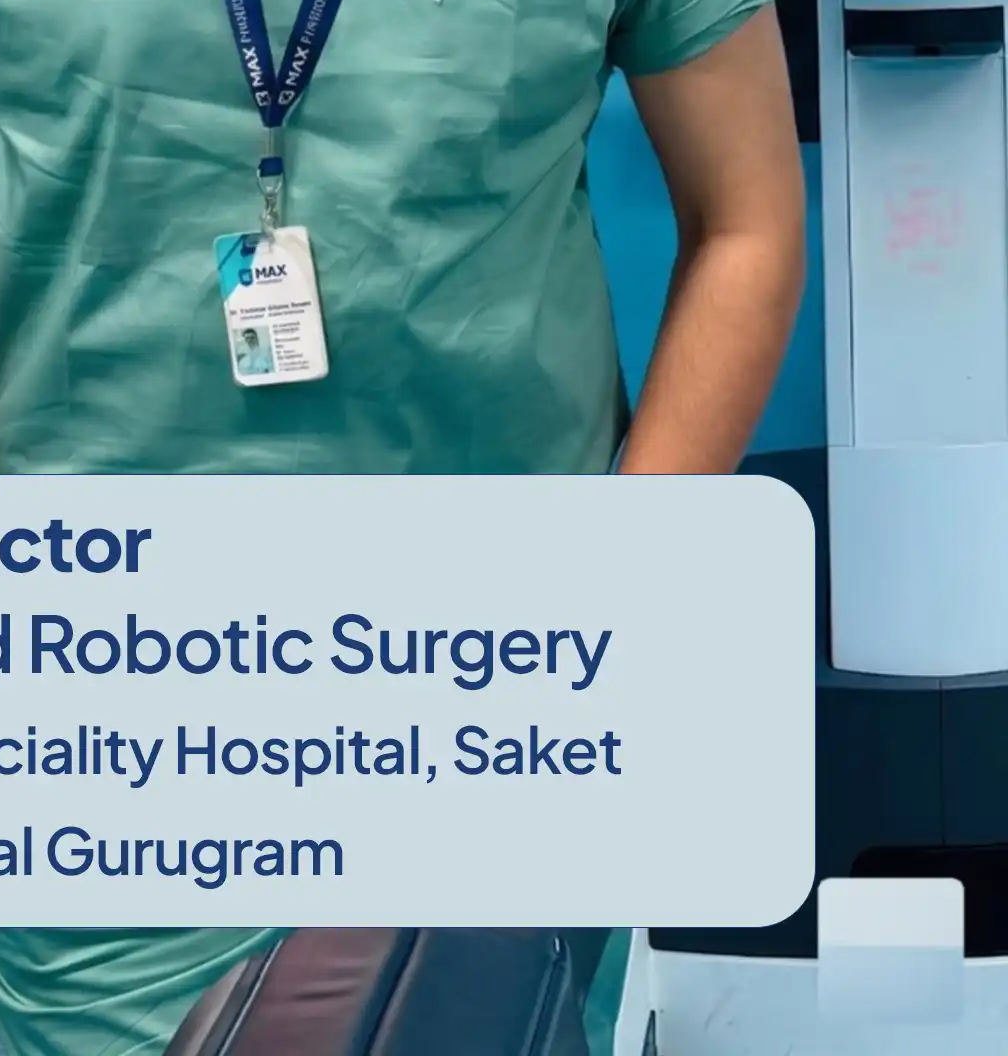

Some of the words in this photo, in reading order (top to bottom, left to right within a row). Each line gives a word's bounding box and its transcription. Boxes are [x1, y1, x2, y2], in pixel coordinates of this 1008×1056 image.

[243, 46, 264, 88] MAX
[285, 46, 310, 86] MAX
[255, 264, 287, 279] MAX
